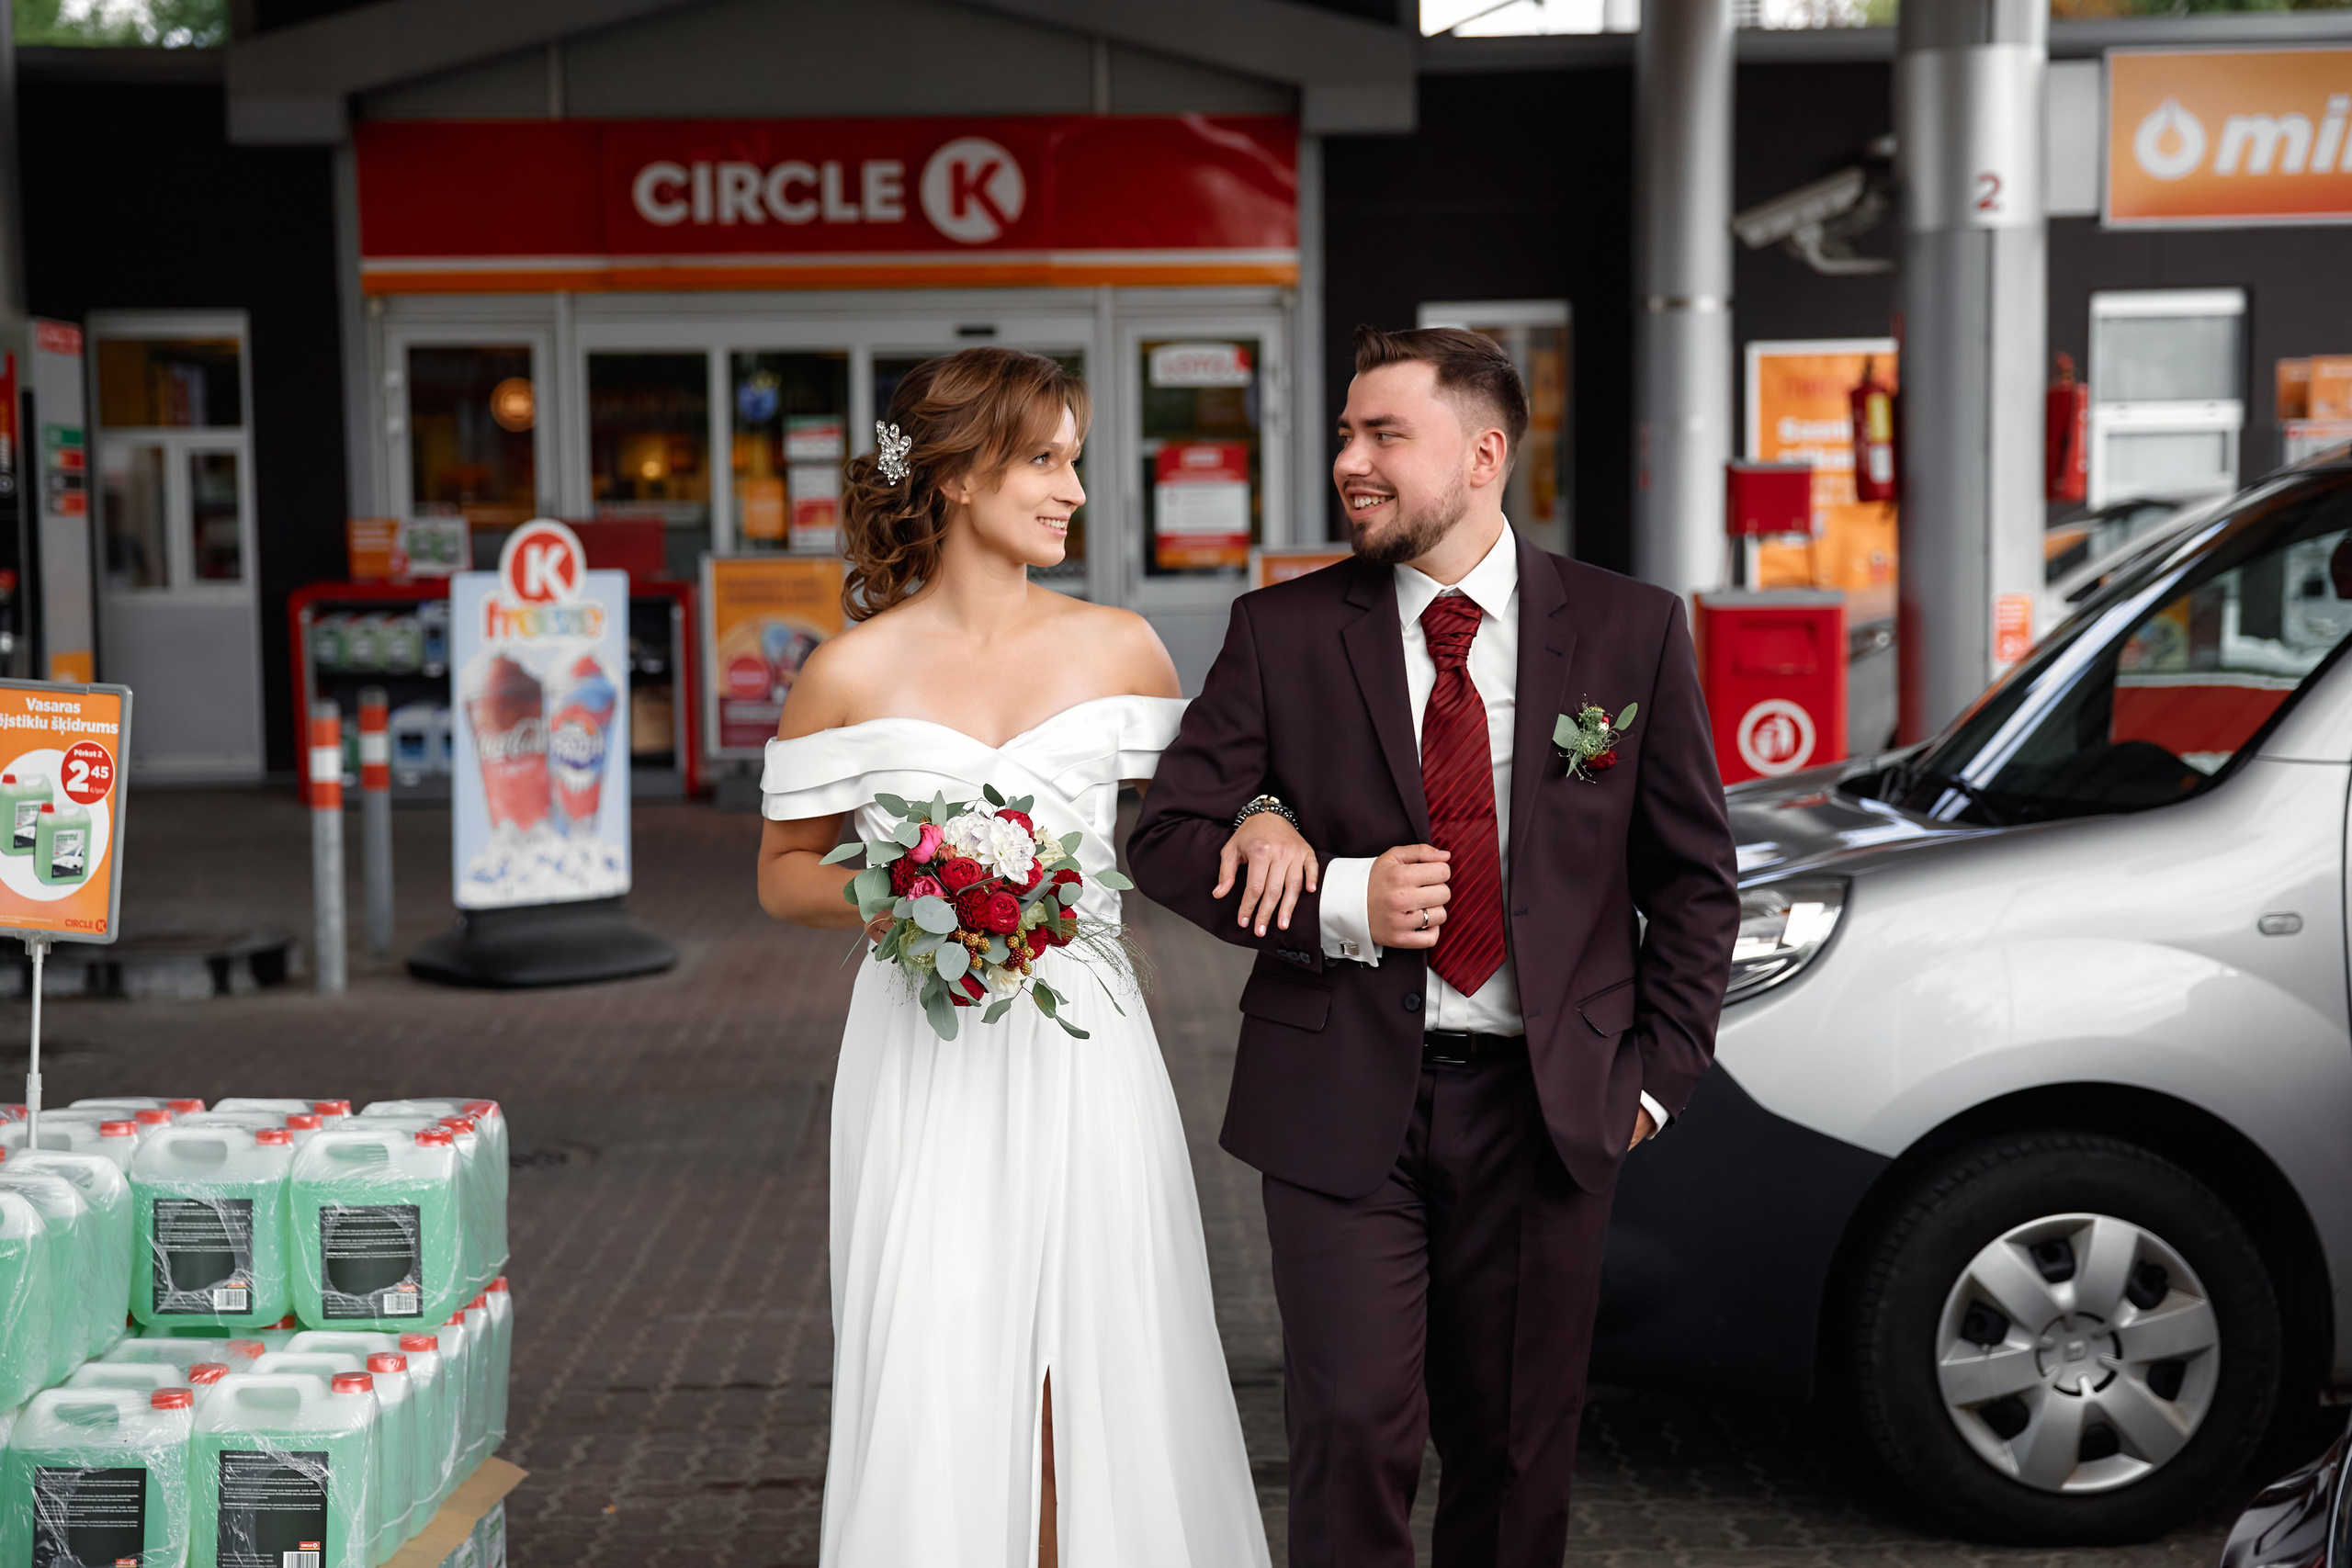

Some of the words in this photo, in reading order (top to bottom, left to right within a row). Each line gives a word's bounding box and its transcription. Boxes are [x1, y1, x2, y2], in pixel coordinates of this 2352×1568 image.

[632, 160, 906, 226] CIRCLE
[944, 153, 1018, 244] K
[1977, 174, 2001, 211] 2
[524, 540, 577, 603] K
[25, 696, 82, 715] Vasaras
[51, 716, 119, 736] šķidrums
[66, 759, 90, 793] 2
[90, 764, 109, 779] 45
[64, 918, 94, 929] CIRCLE
